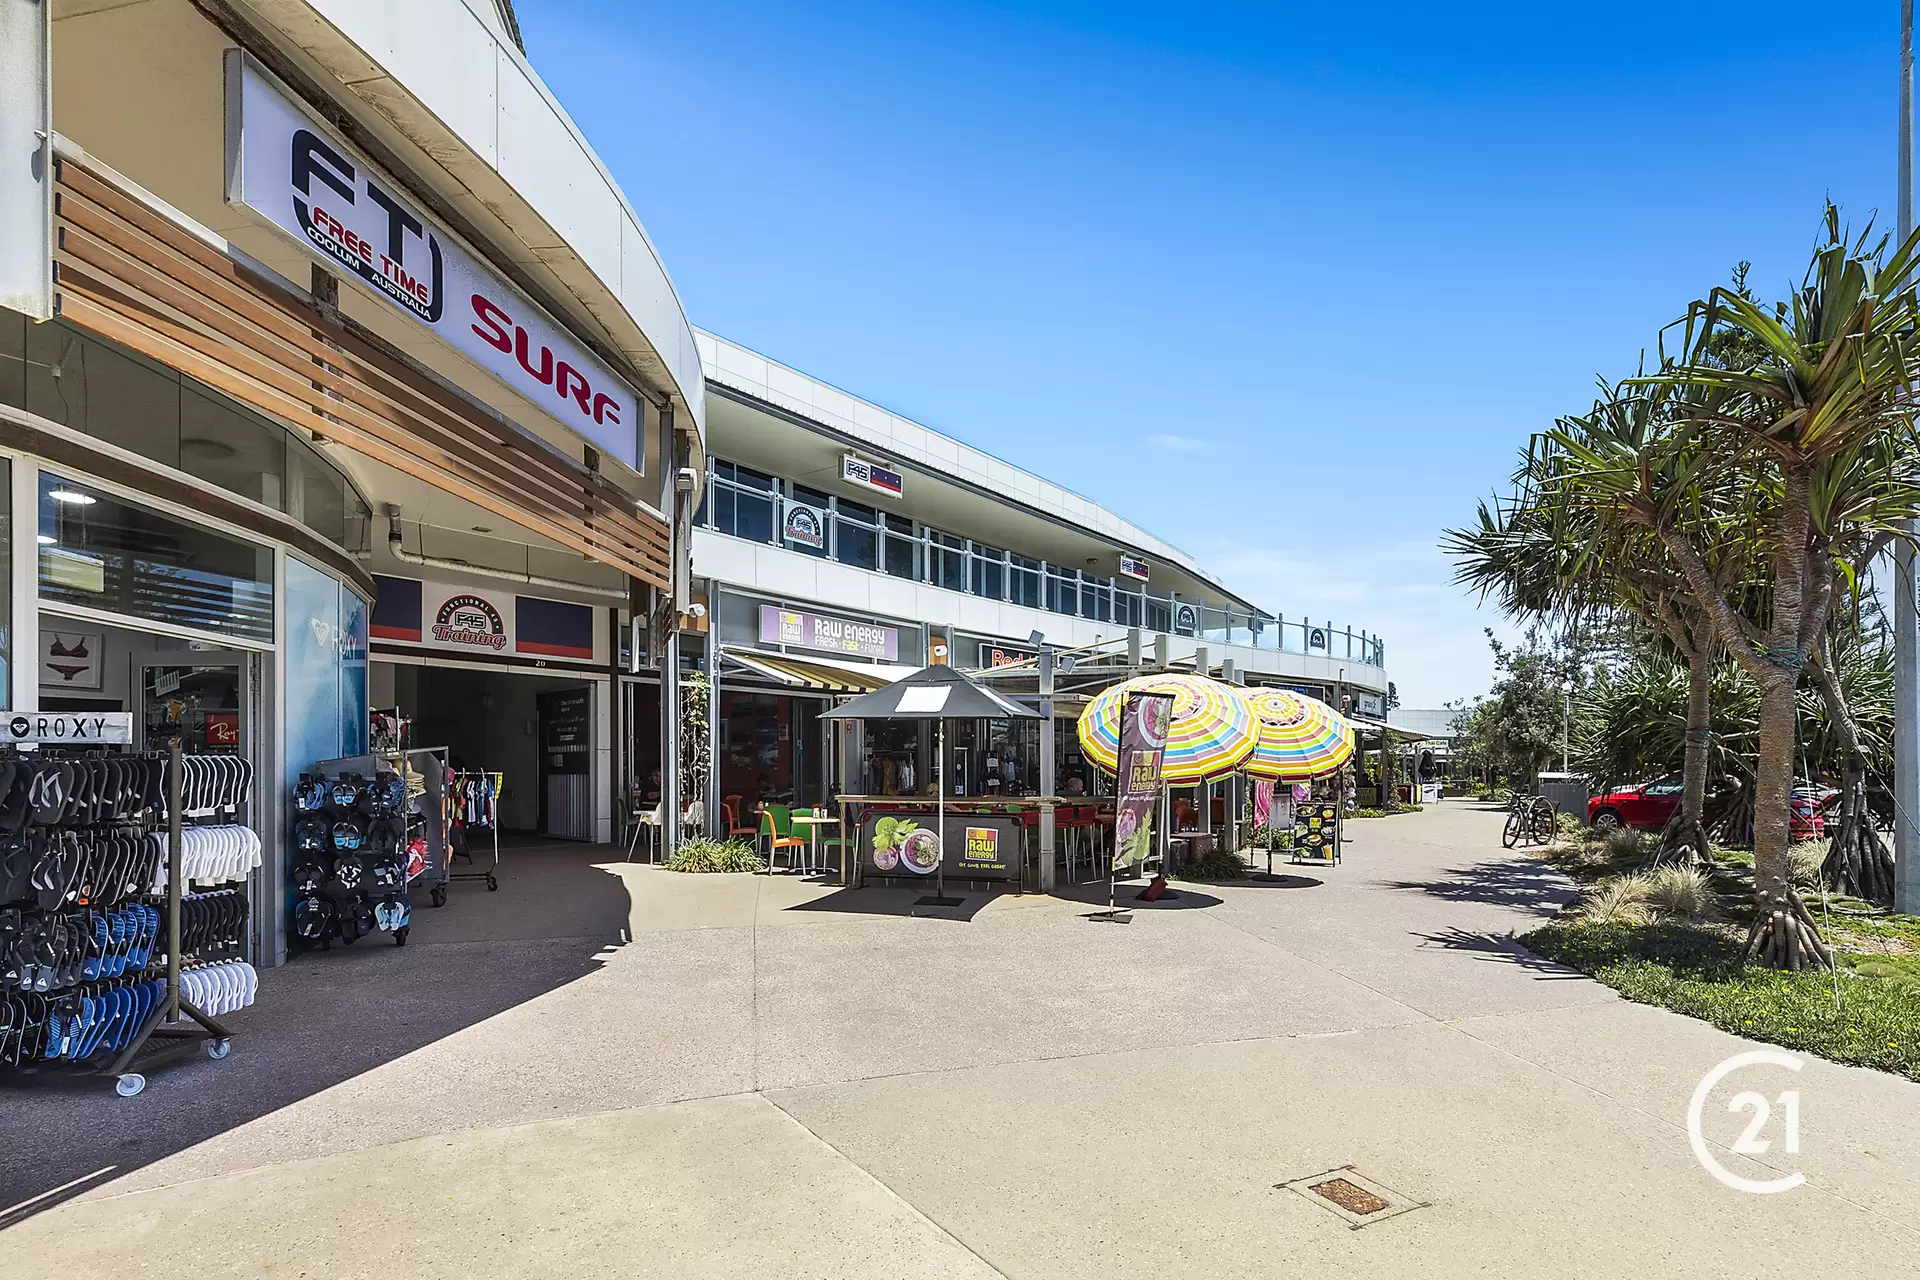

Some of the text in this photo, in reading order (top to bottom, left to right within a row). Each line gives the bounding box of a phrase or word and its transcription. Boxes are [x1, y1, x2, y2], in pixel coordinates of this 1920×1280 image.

[313, 207, 428, 304] FREE TIME
[307, 226, 432, 320] COOLUM AUSTRALIA
[470, 294, 621, 425] SURF
[848, 461, 868, 480] F45
[442, 598, 489, 616] FUNCTIONAL
[456, 613, 485, 628] F45
[432, 624, 507, 650] Training
[37, 718, 106, 738] ROXY
